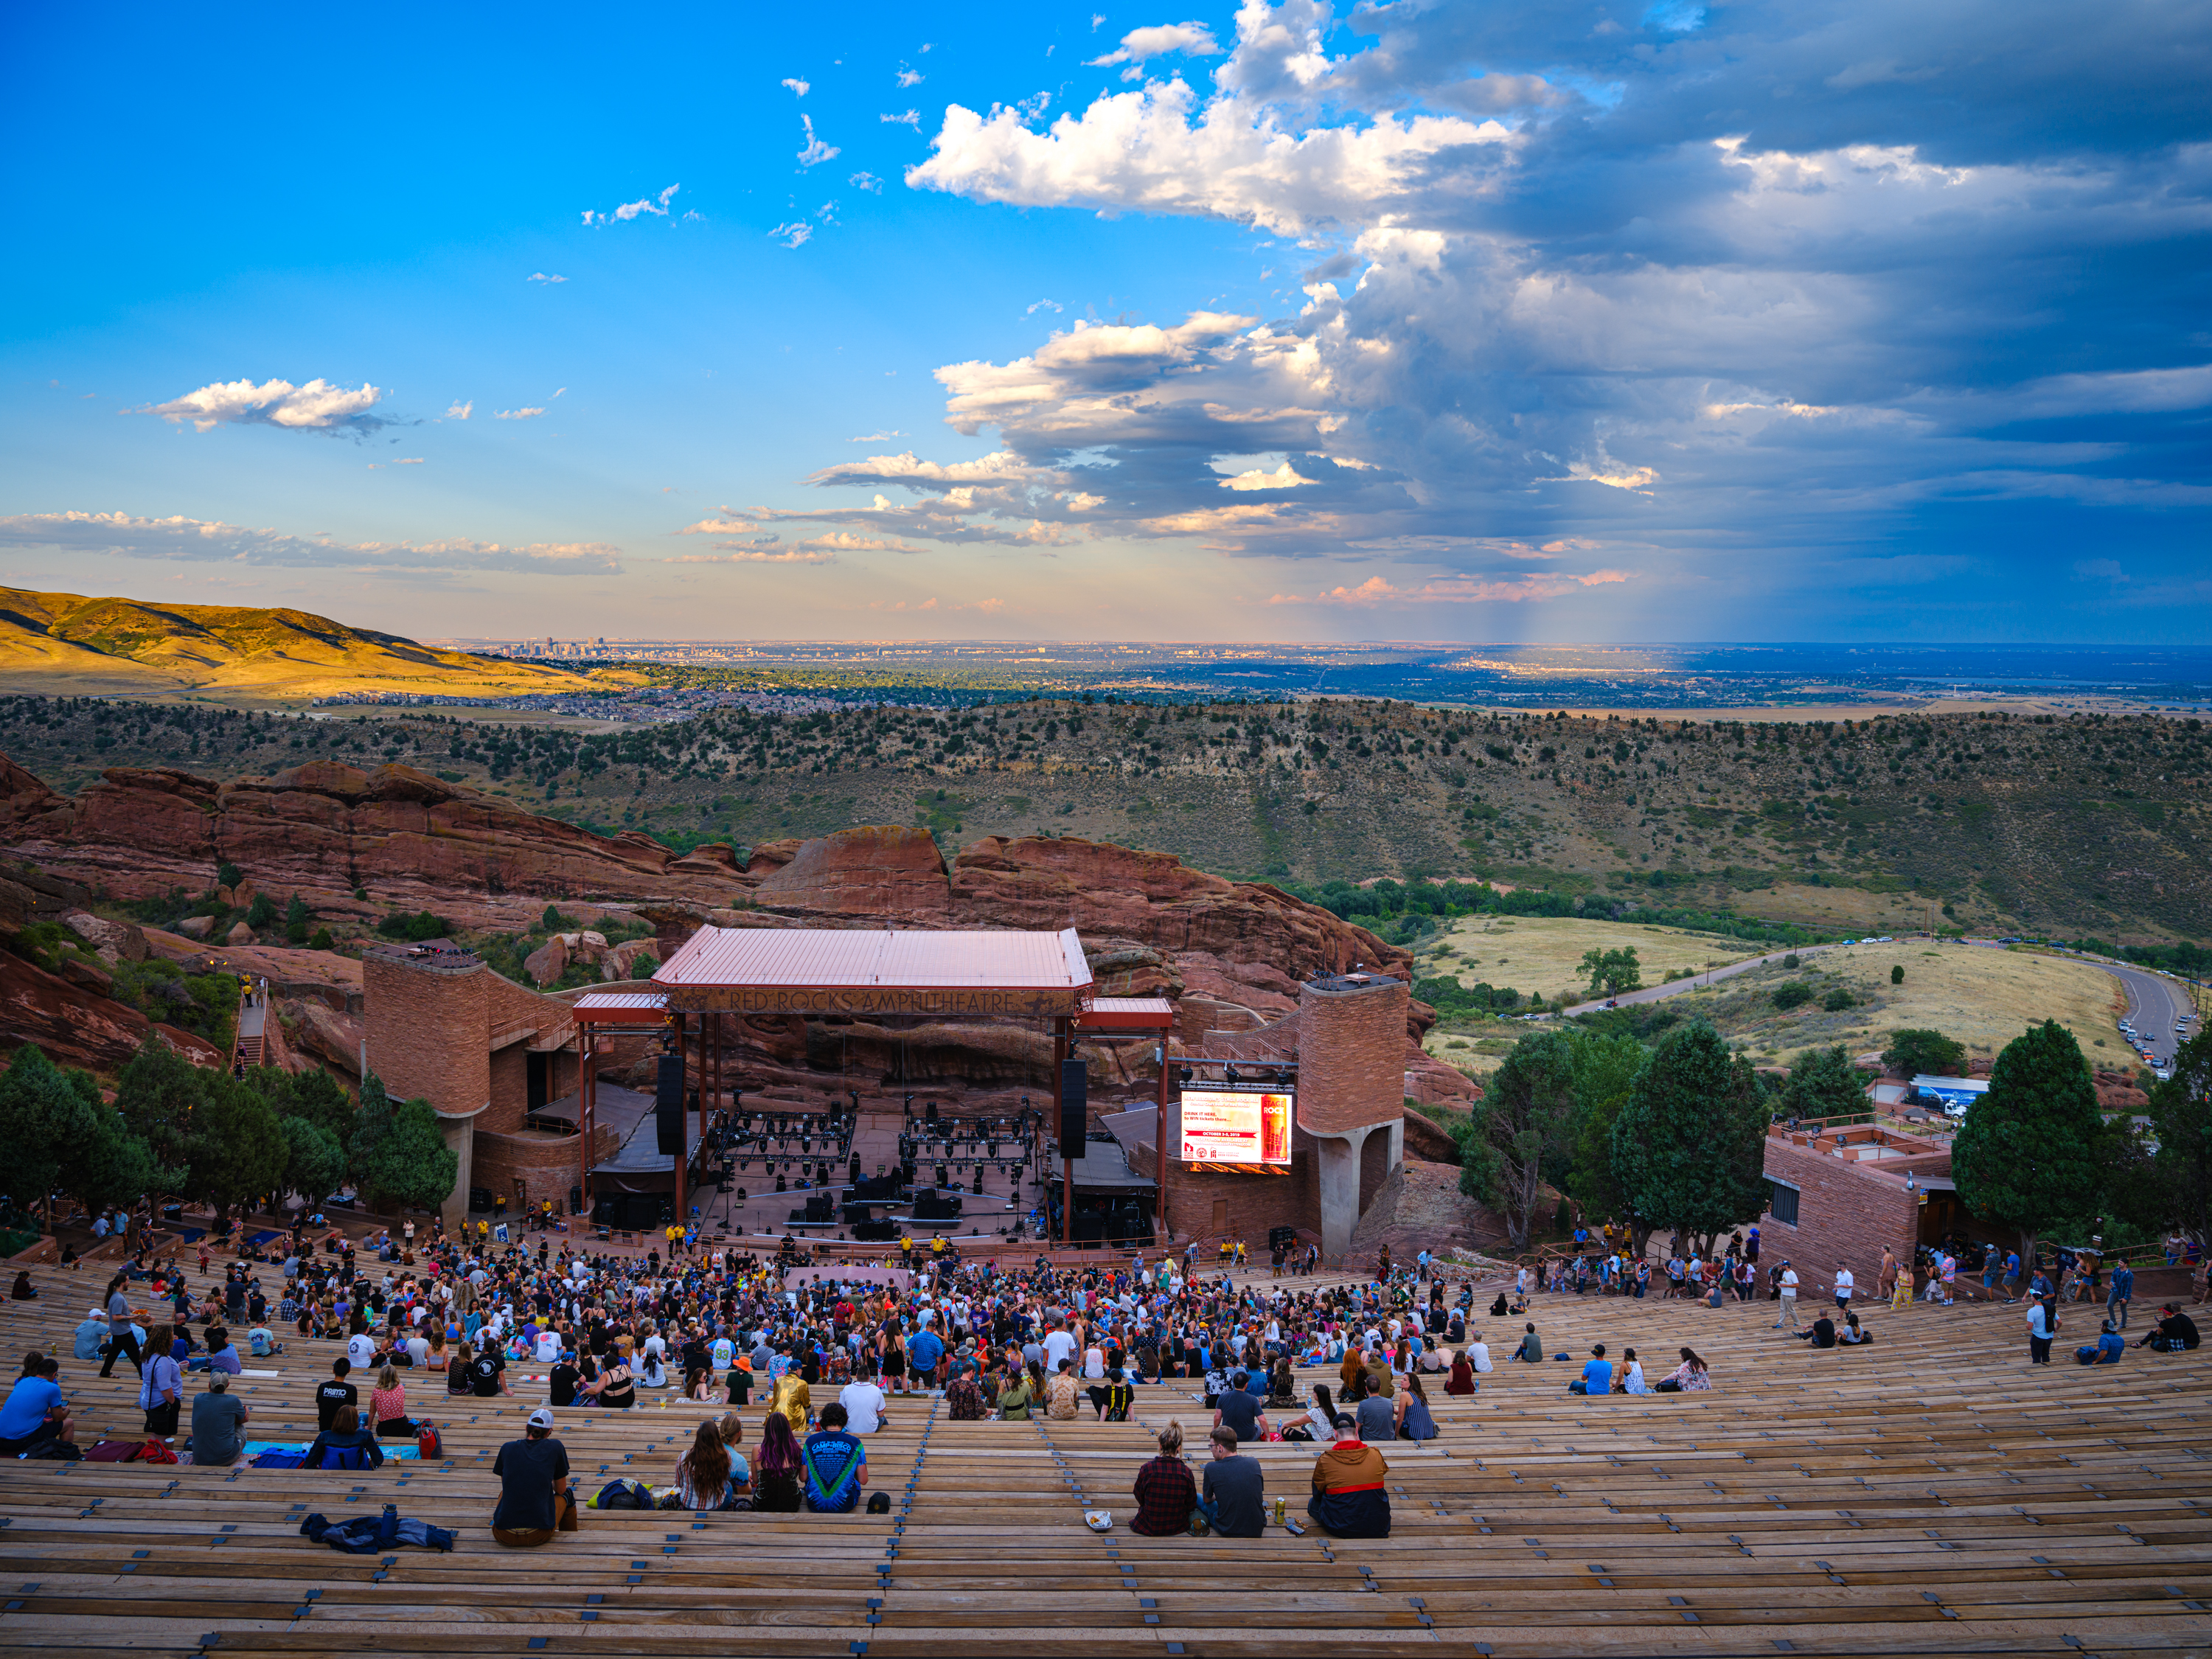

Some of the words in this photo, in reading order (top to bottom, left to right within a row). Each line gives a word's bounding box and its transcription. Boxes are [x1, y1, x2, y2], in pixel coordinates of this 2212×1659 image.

[730, 992, 768, 1010] RED
[778, 992, 853, 1012] ROCKS
[862, 992, 1013, 1012] AMPHITHEATRE
[715, 1348, 728, 1360] 93
[324, 1387, 347, 1396] PRIMO
[812, 1443, 830, 1451] CAMP
[832, 1443, 852, 1451] BISCO
